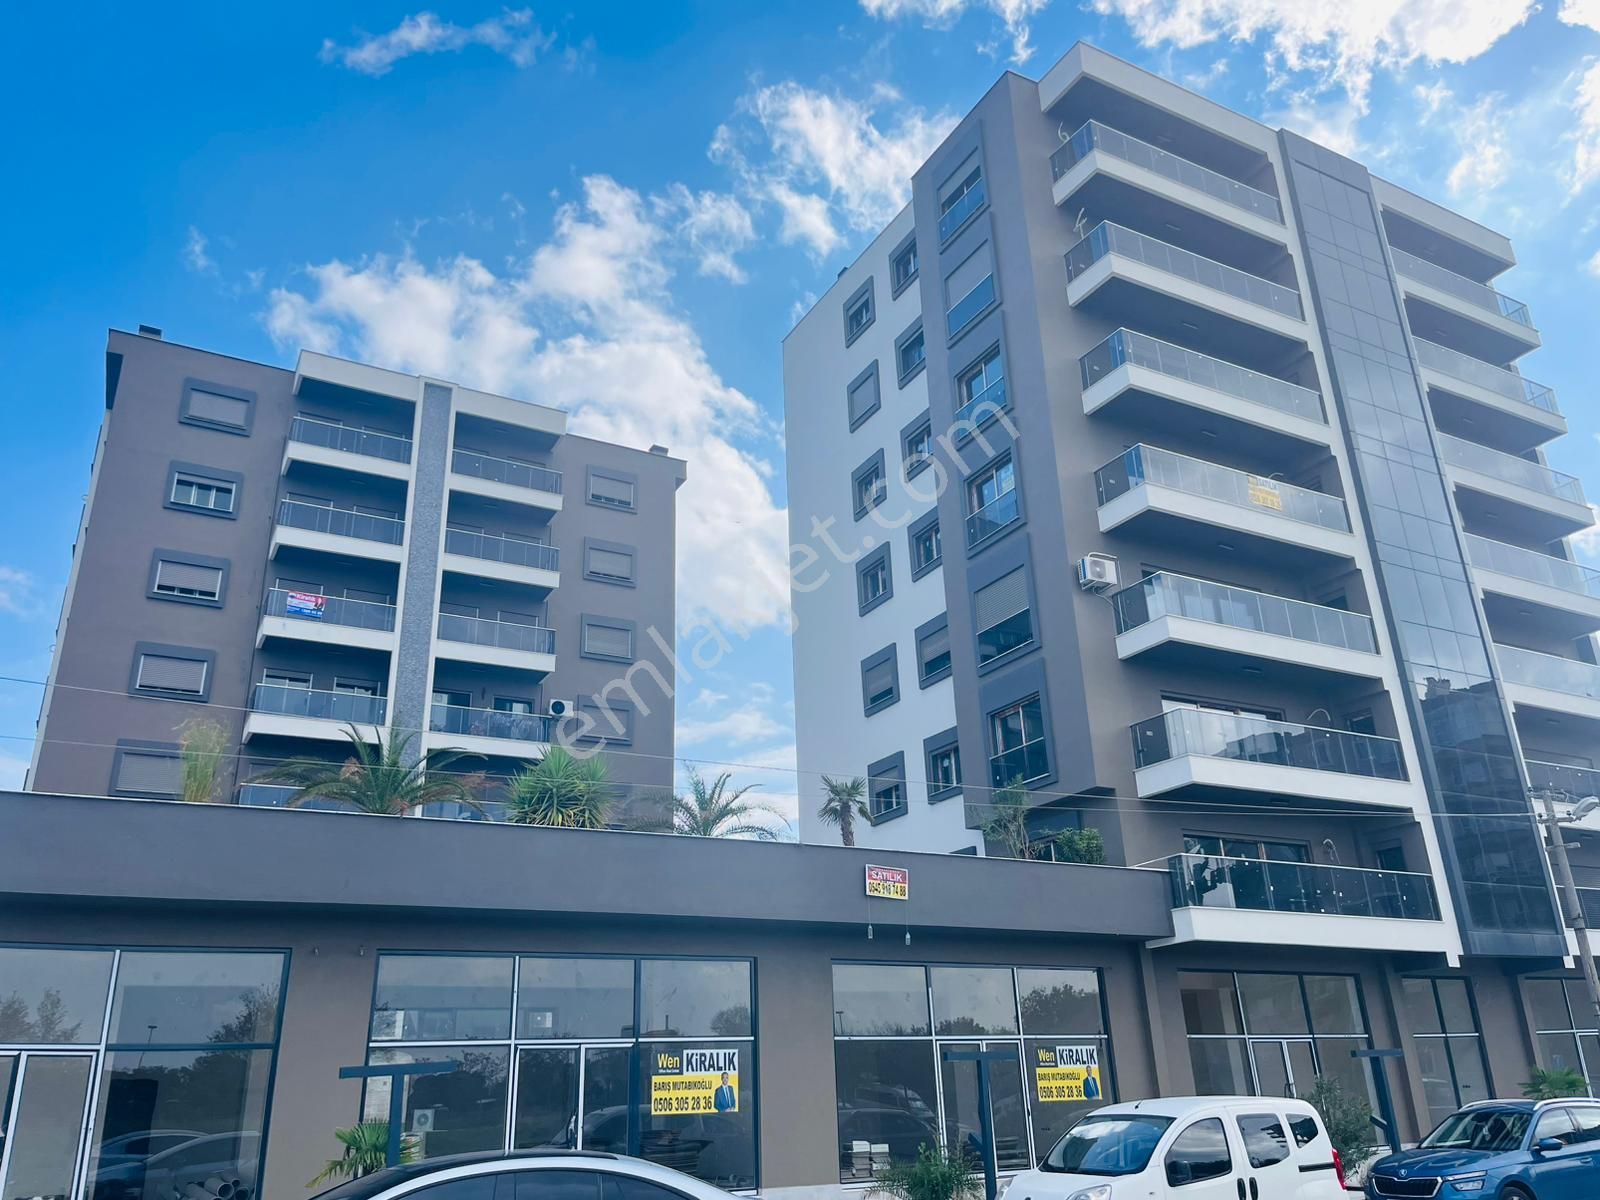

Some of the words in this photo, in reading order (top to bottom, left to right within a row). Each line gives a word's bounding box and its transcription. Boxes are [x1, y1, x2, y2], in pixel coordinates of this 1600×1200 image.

[871, 870, 903, 882] SATILIK
[657, 1053, 680, 1068] Wen
[1038, 1049, 1055, 1062] Wen
[653, 1081, 671, 1093] BARIŞ
[1039, 1086, 1054, 1099] 0506
[1055, 1086, 1066, 1098] 305
[653, 1097, 673, 1112] 0506
[674, 1096, 689, 1111] 305
[691, 1096, 700, 1110] 28
[702, 1095, 713, 1110] 36
